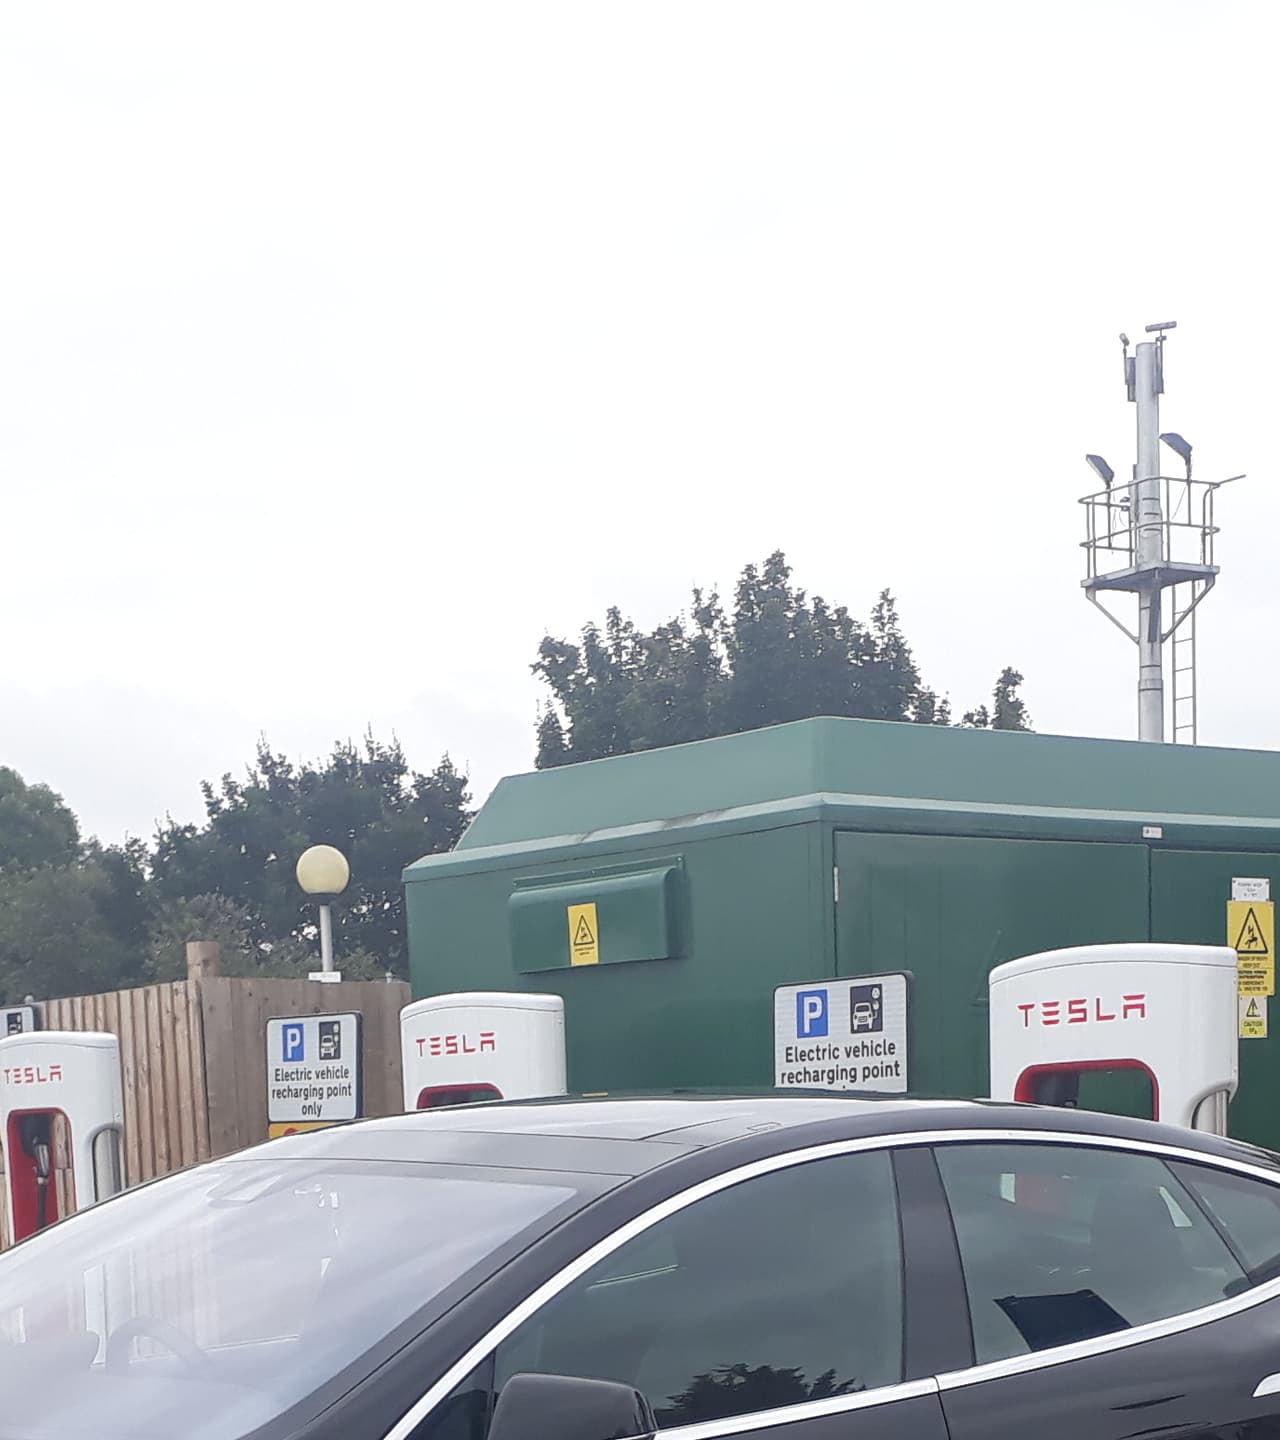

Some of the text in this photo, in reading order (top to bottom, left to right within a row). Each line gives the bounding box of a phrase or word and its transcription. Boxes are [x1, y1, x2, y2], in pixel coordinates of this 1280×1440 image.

[803, 995, 823, 1034] P
[1017, 994, 1146, 1028] TESLA
[287, 1028, 300, 1059] P
[416, 1032, 496, 1057] TESLA
[785, 1038, 896, 1063] Electric vehicle
[4, 1065, 62, 1084] TESLA
[274, 1065, 350, 1082] Electric vehicle
[780, 1060, 900, 1085] recharging point
[272, 1083, 352, 1101] recharging point
[301, 1101, 322, 1118] only
